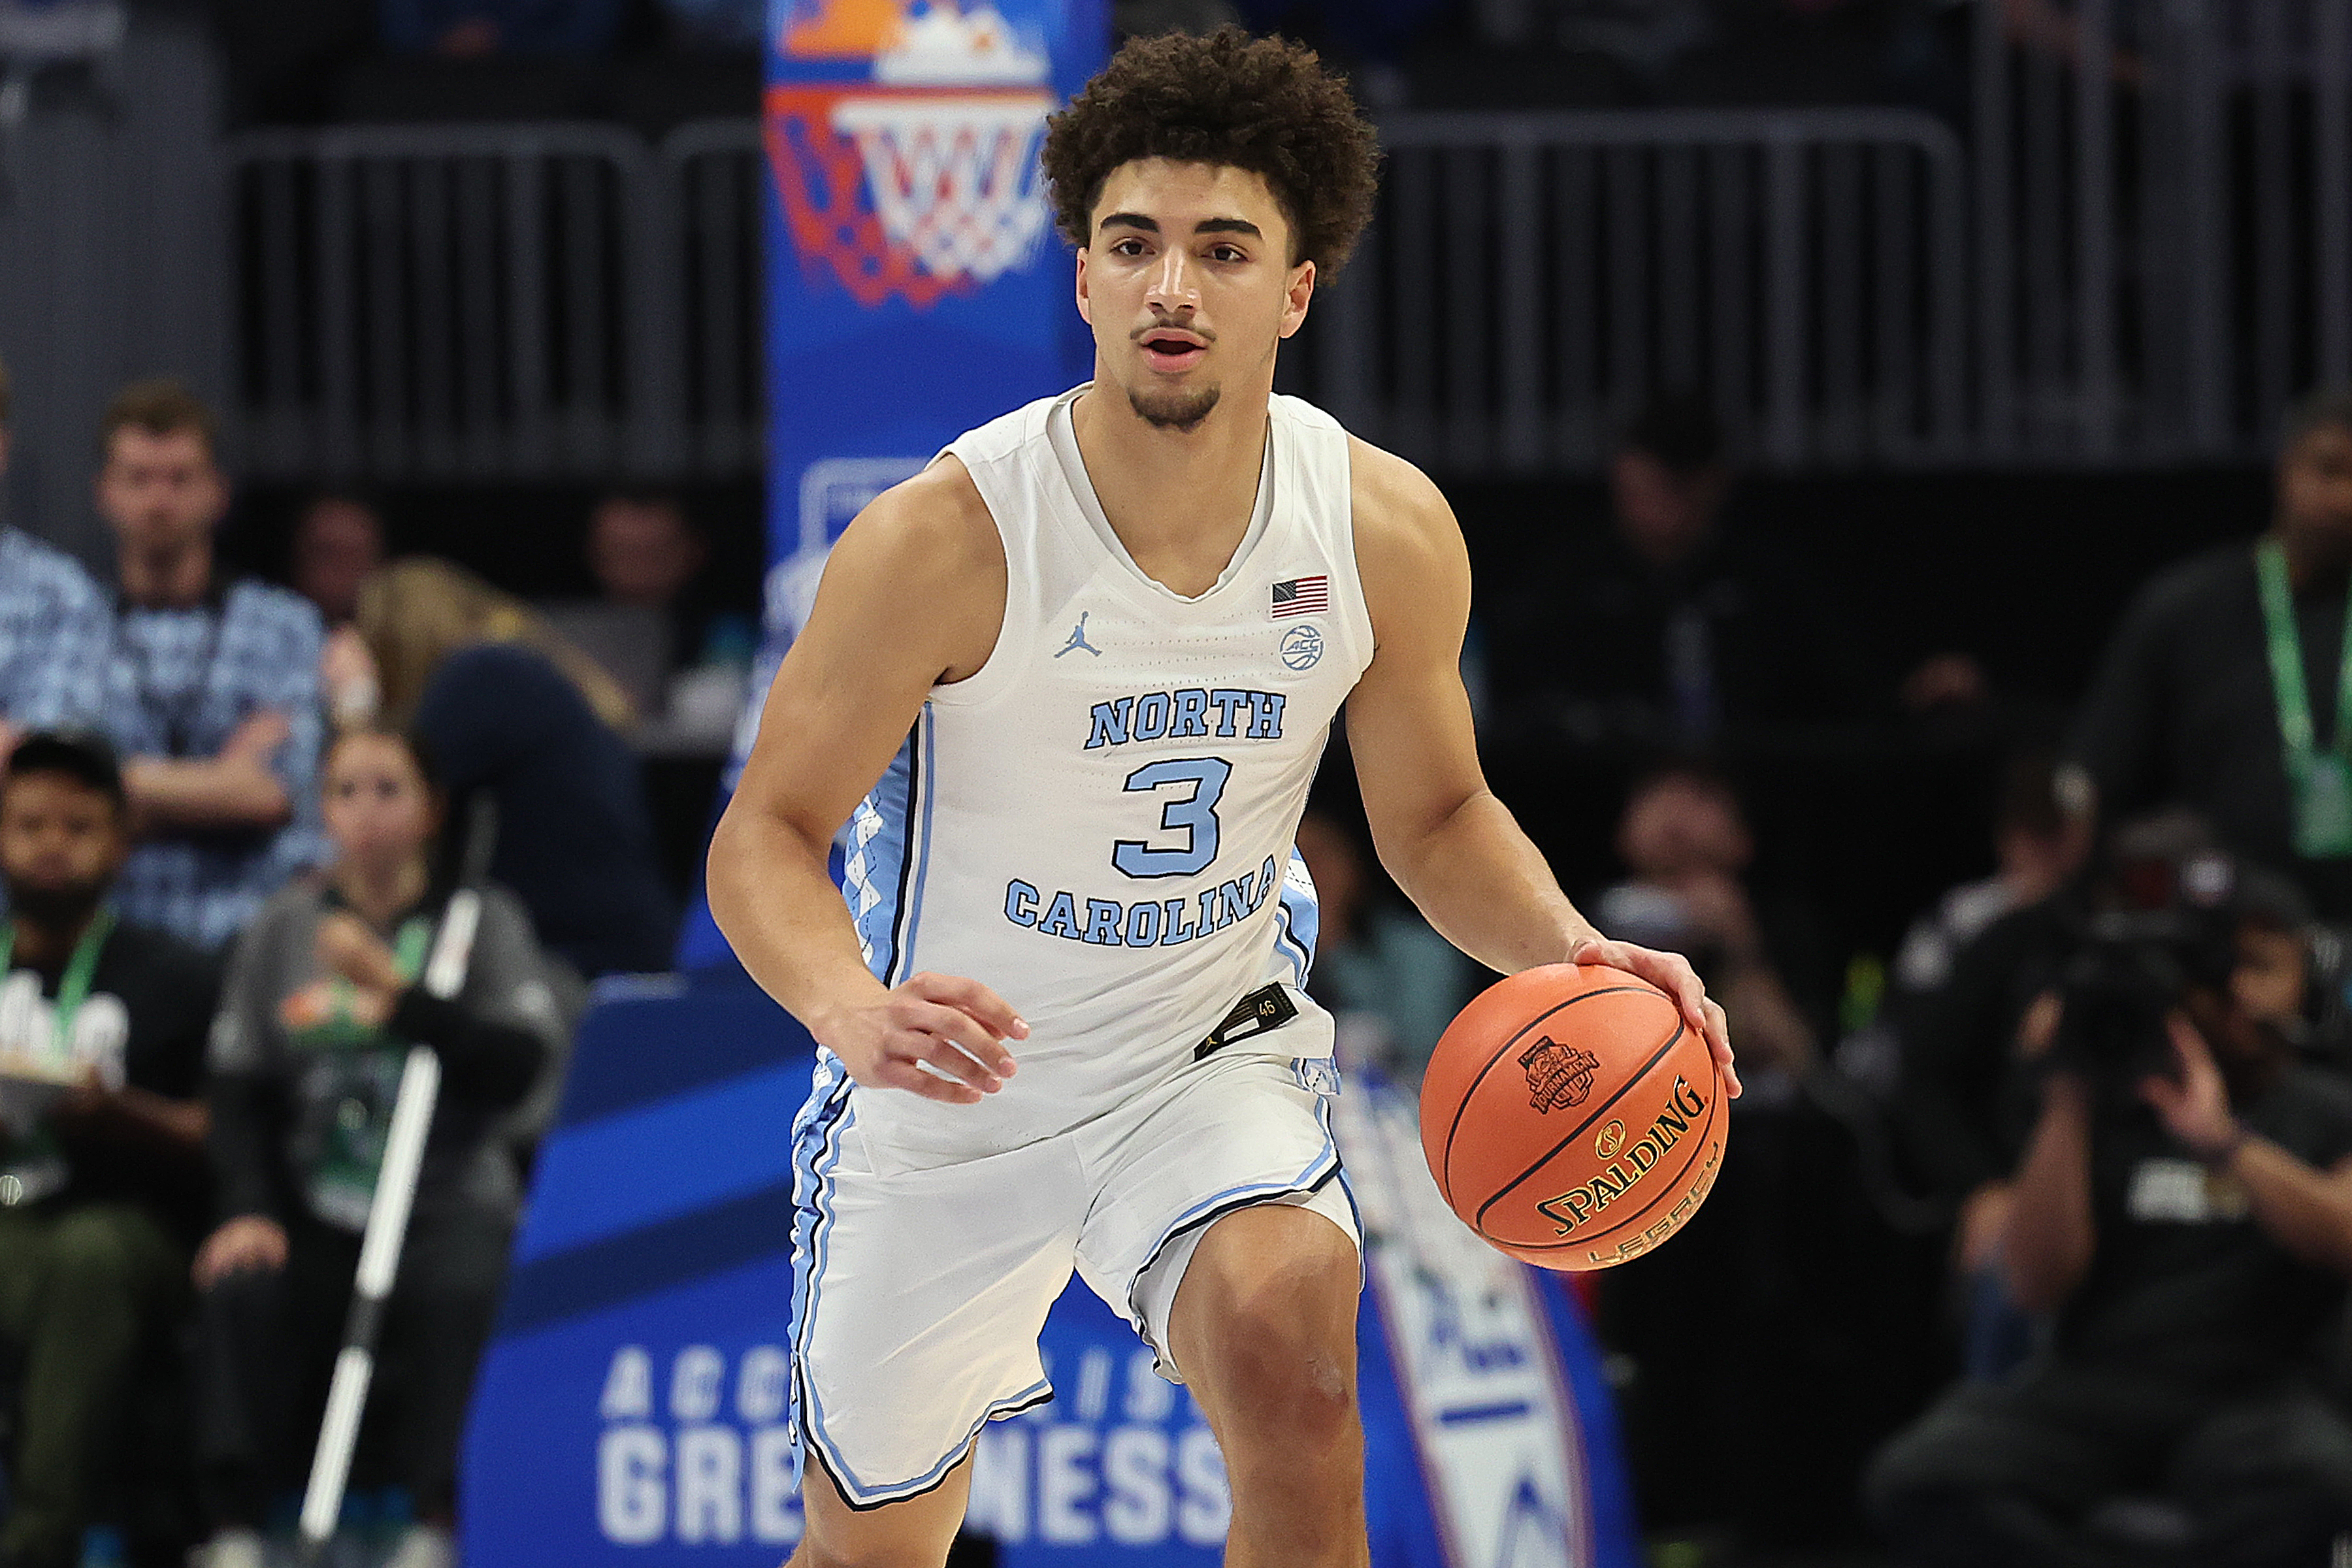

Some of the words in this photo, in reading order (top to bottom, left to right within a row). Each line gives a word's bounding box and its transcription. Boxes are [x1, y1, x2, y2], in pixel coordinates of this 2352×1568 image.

[1083, 688, 1286, 750] NORTH
[1111, 757, 1233, 879] 3
[1004, 854, 1277, 948] CAROLINA
[1259, 1000, 1276, 1017] 46
[1529, 1050, 1600, 1115] TOURNAMENT
[1536, 1074, 1707, 1238] SPALDING
[1588, 1141, 1719, 1264] LEGACY
